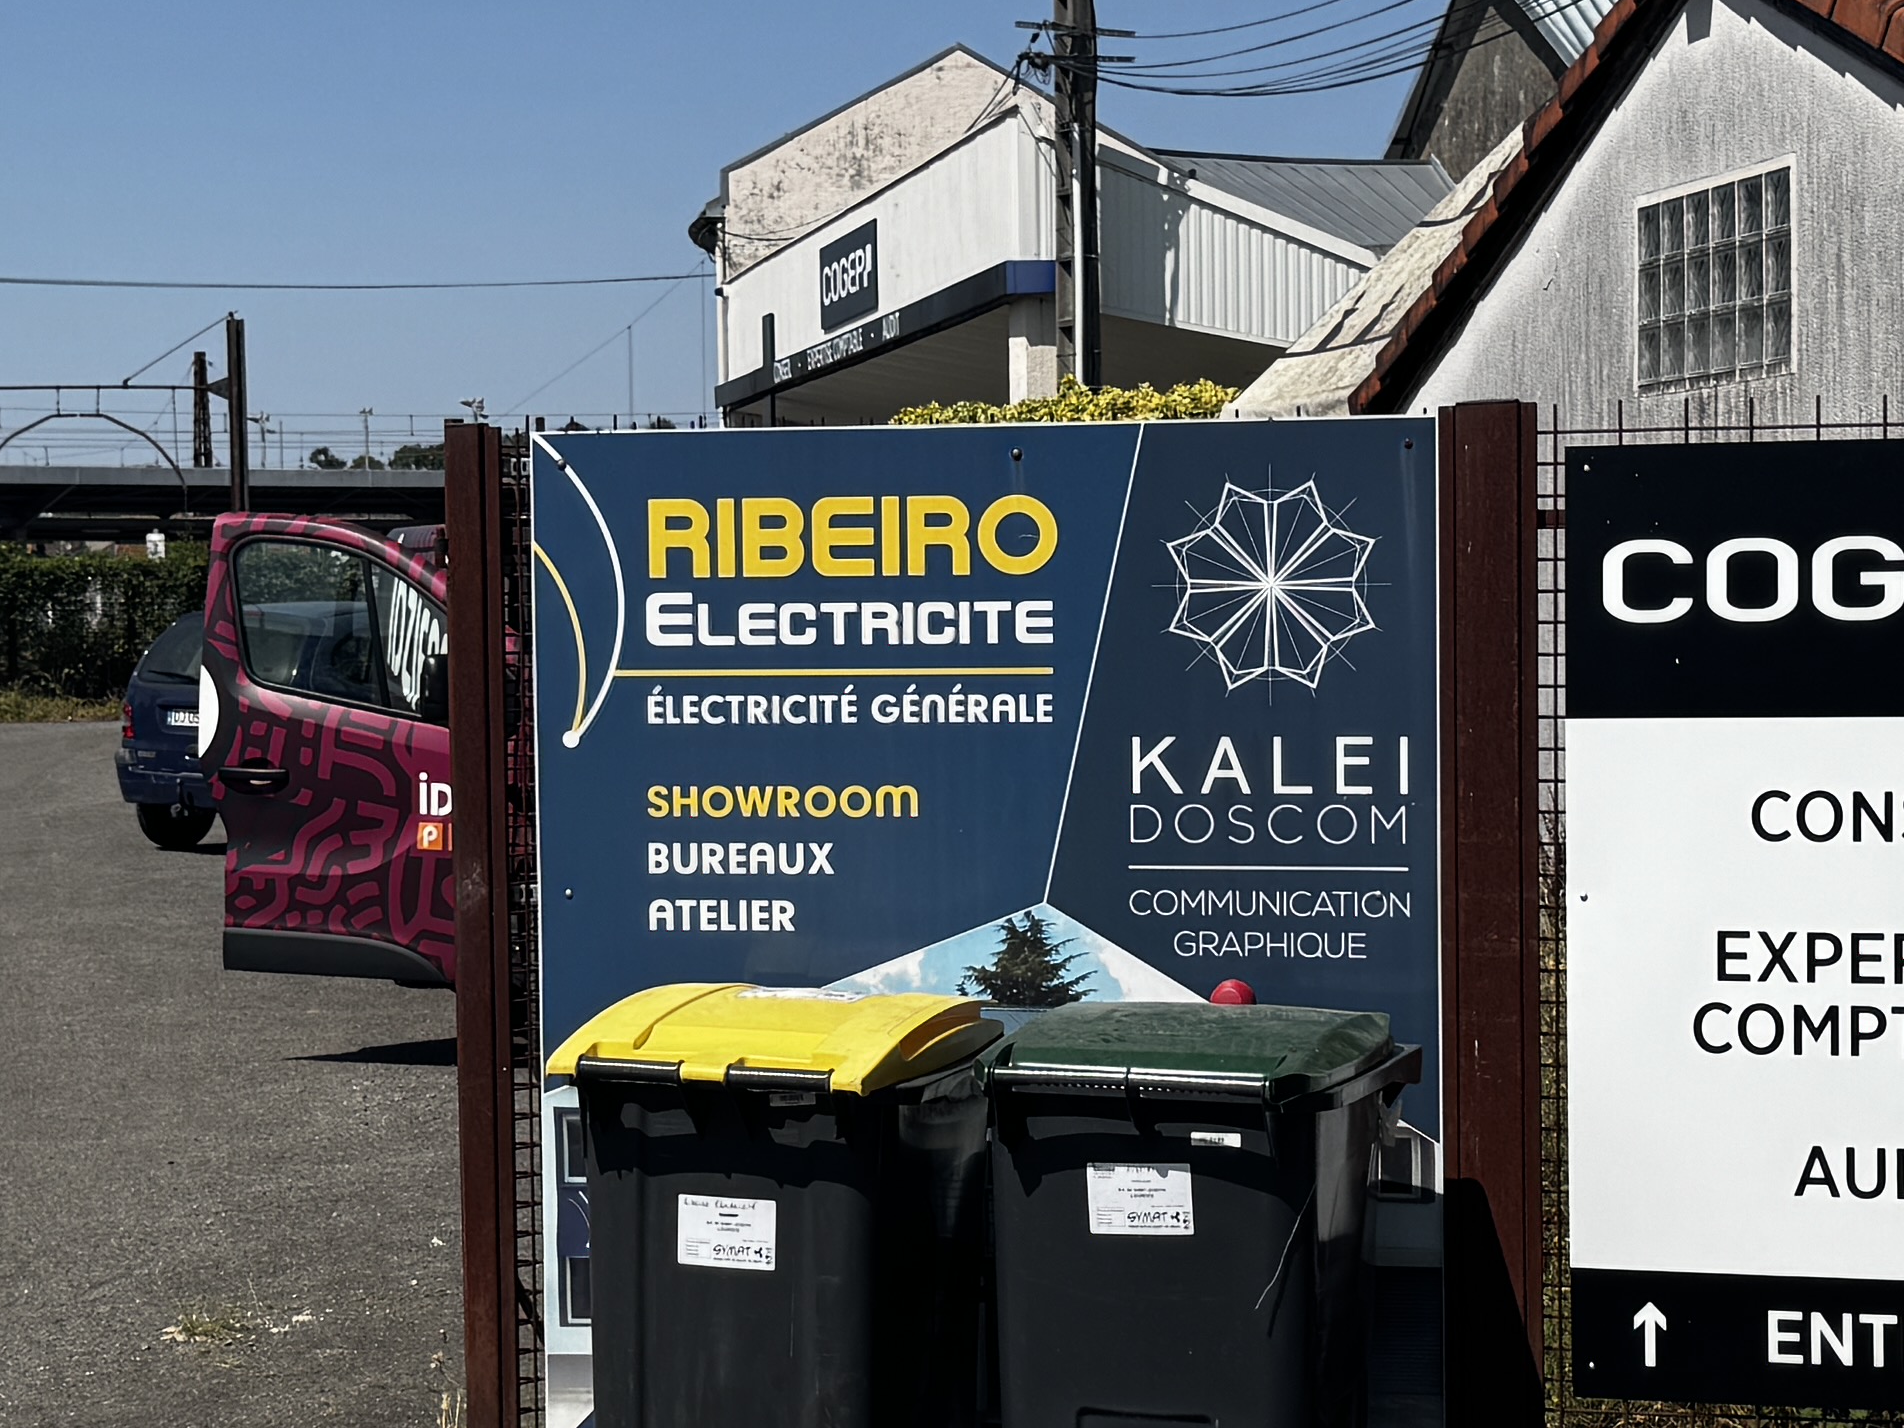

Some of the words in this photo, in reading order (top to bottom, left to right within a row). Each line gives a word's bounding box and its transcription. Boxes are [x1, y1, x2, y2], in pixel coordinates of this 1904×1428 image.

[822, 248, 865, 306] COGEP
[648, 495, 1059, 579] RIBEIRO
[646, 592, 1054, 646] ELECTRICITE
[647, 684, 858, 724] ÉLECTRICITÉ
[870, 683, 1053, 724] GÉNÉRALE
[1131, 736, 1409, 795] KALEI
[647, 785, 919, 818] SHOWROOM
[1129, 803, 1407, 845] DOSCOM
[648, 841, 835, 875] BUREAUX
[648, 898, 796, 932] ATELIER
[1128, 889, 1411, 918] COMMUNICATION
[1173, 930, 1367, 960] GRAPHIQUE
[1127, 1211, 1168, 1223] SYMAT
[713, 1244, 751, 1256] SYMAT
